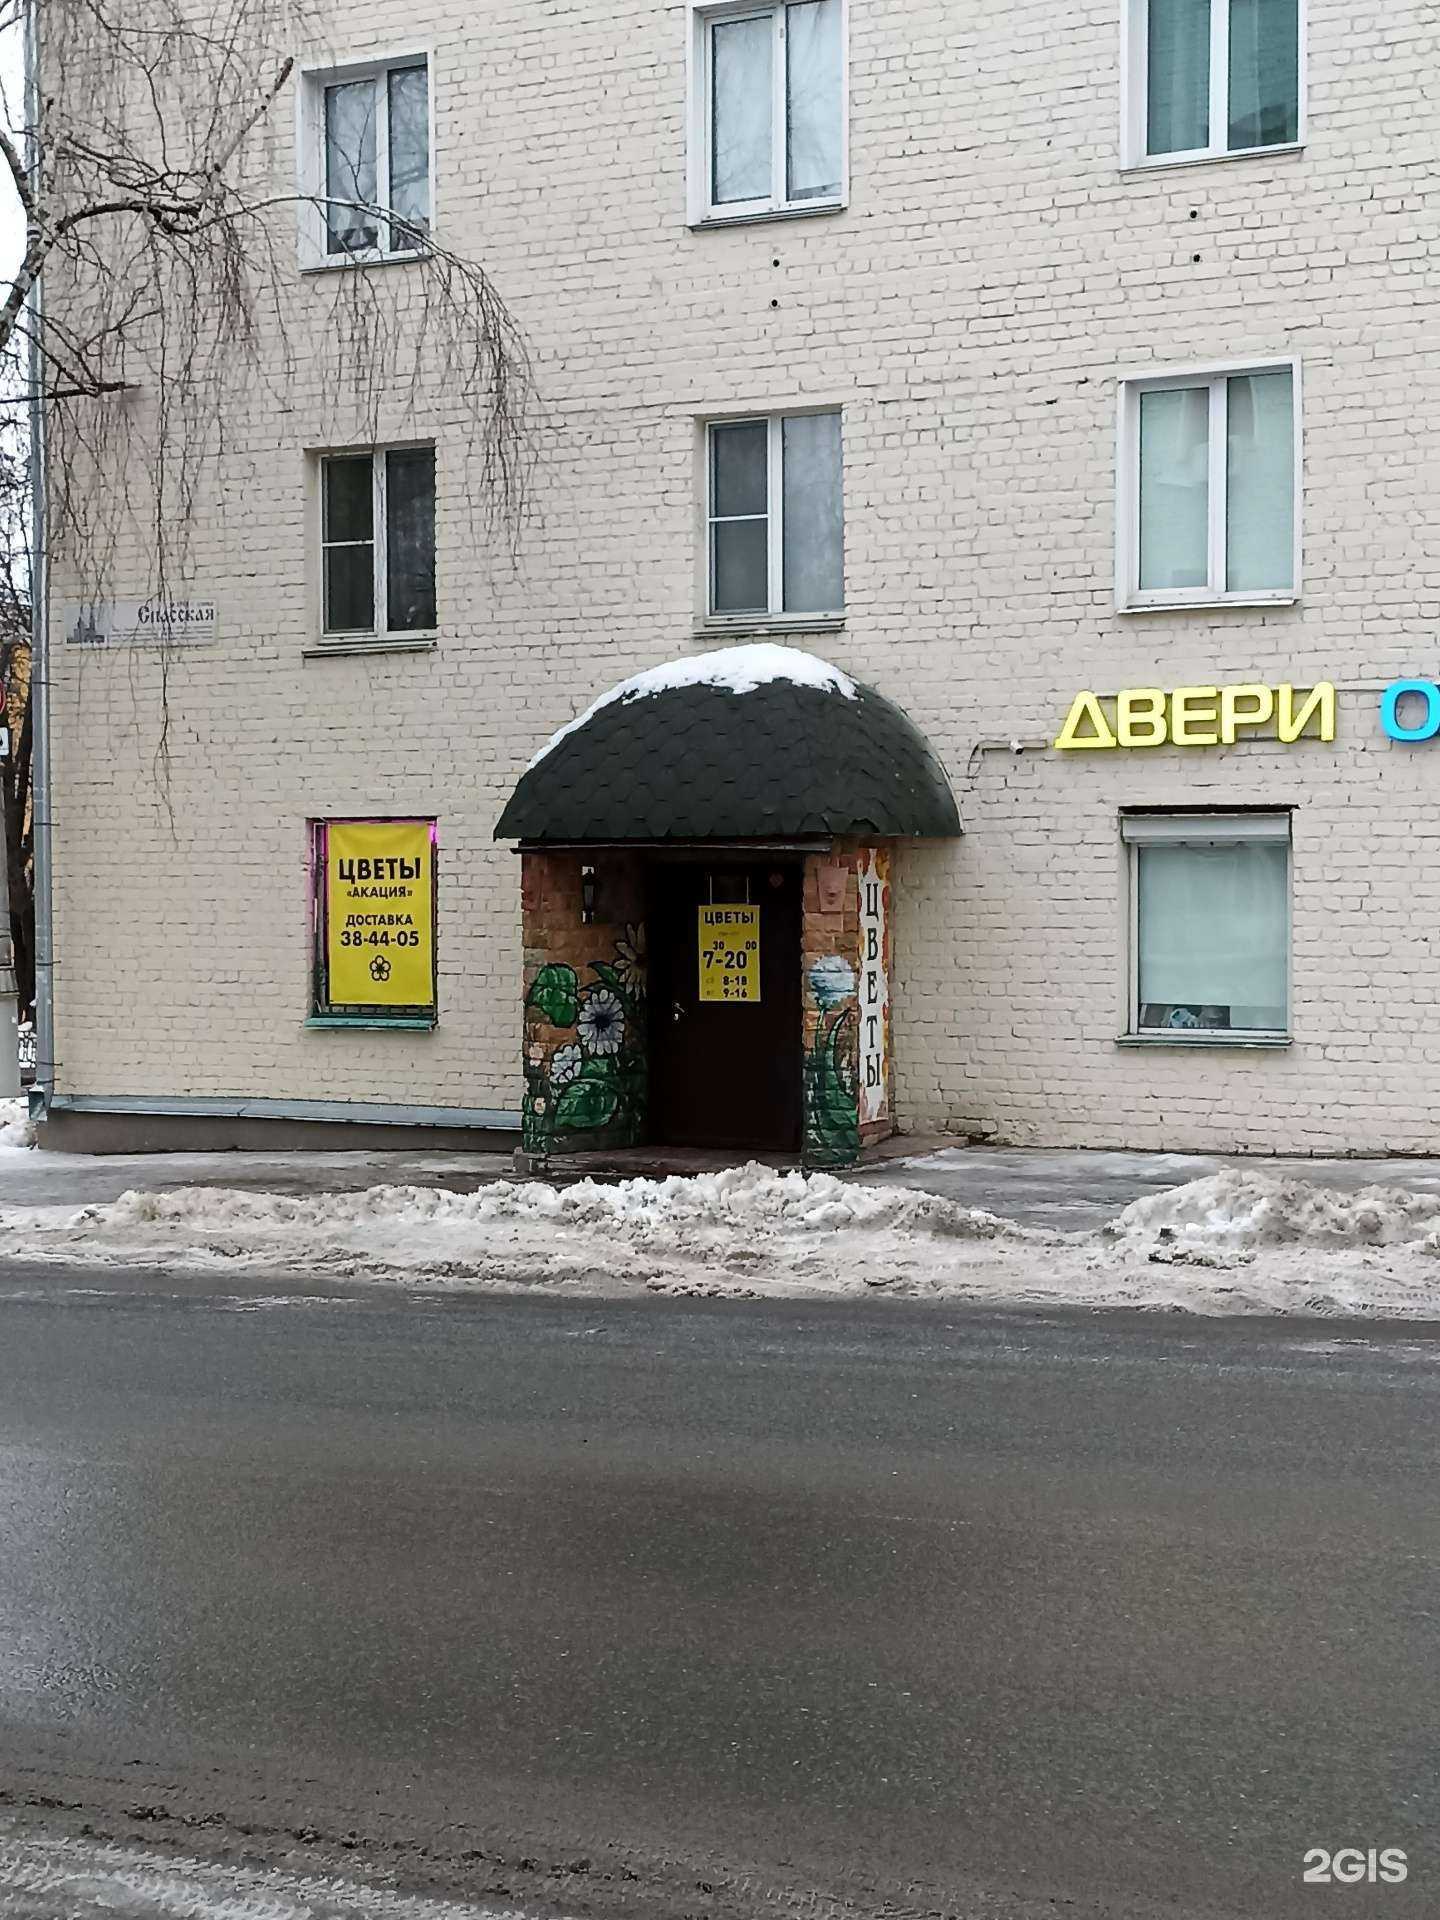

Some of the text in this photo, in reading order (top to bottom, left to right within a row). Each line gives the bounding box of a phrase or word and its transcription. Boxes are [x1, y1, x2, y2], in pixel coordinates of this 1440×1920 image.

[138, 606, 214, 624] Спасская
[1054, 681, 1336, 749] ДВЕРИ
[339, 857, 421, 884] ЦВЕТЫ
[345, 914, 413, 927] ДОСТАВКА
[704, 911, 754, 926] ЦВЕТЫ
[340, 931, 420, 946] 38-44-05
[722, 976, 747, 986] 8-18
[865, 883, 881, 1089] ЦВЕТЫ
[722, 988, 747, 998] 9-16
